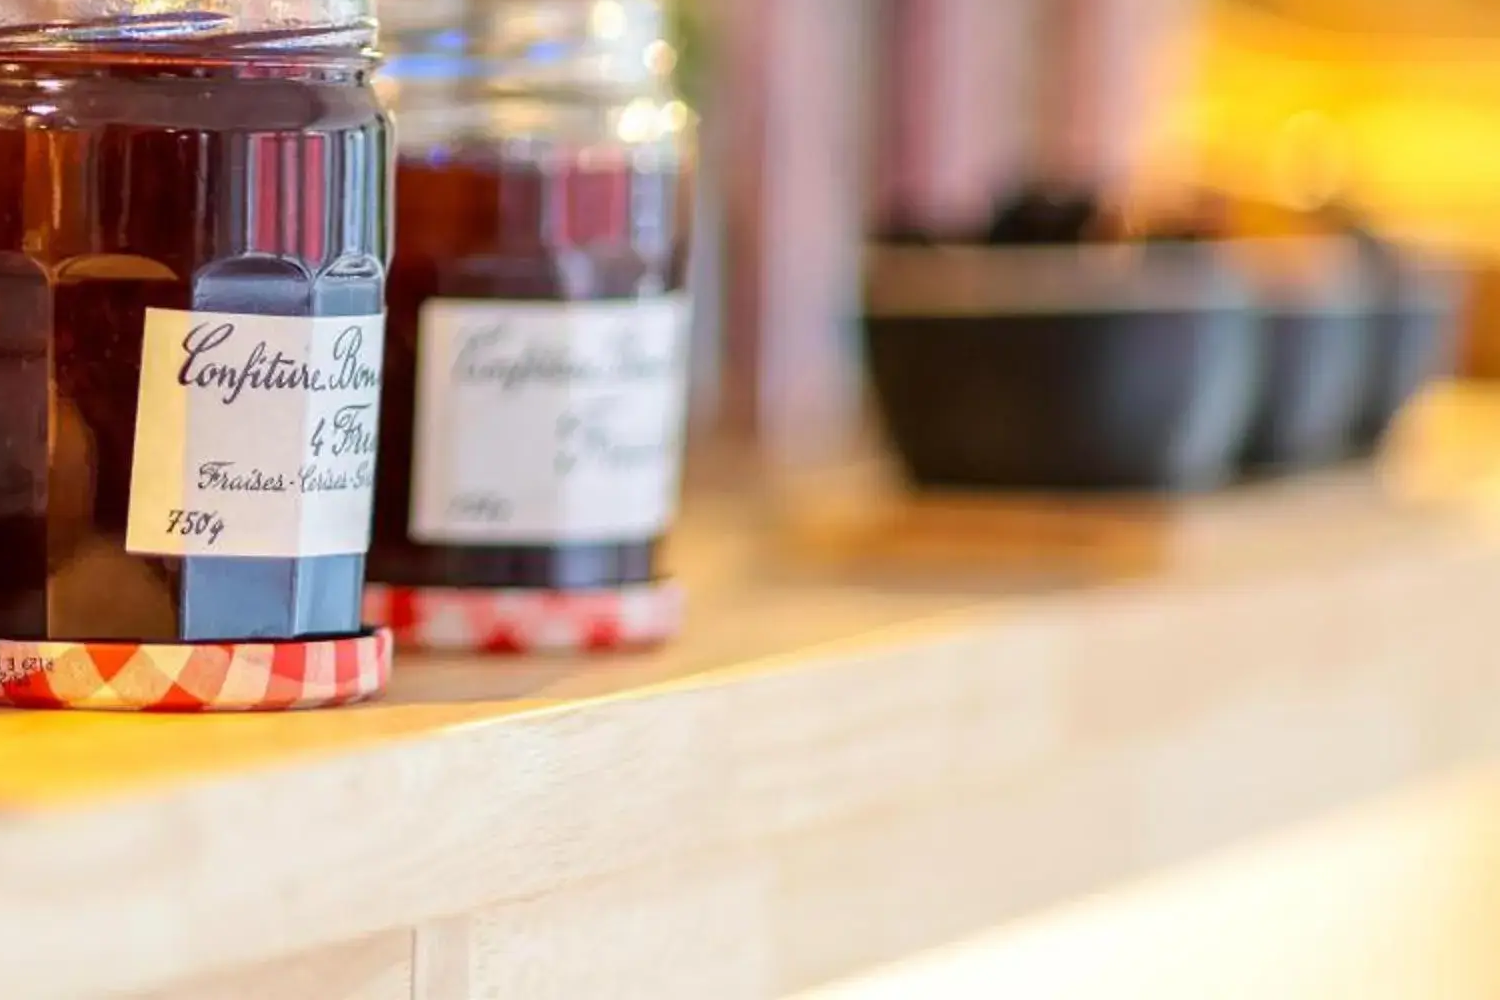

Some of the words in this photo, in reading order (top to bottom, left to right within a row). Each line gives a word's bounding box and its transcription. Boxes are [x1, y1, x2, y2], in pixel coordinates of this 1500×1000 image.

[177, 322, 327, 405] Confiture
[311, 417, 325, 457] 4
[166, 510, 225, 545] 750g
